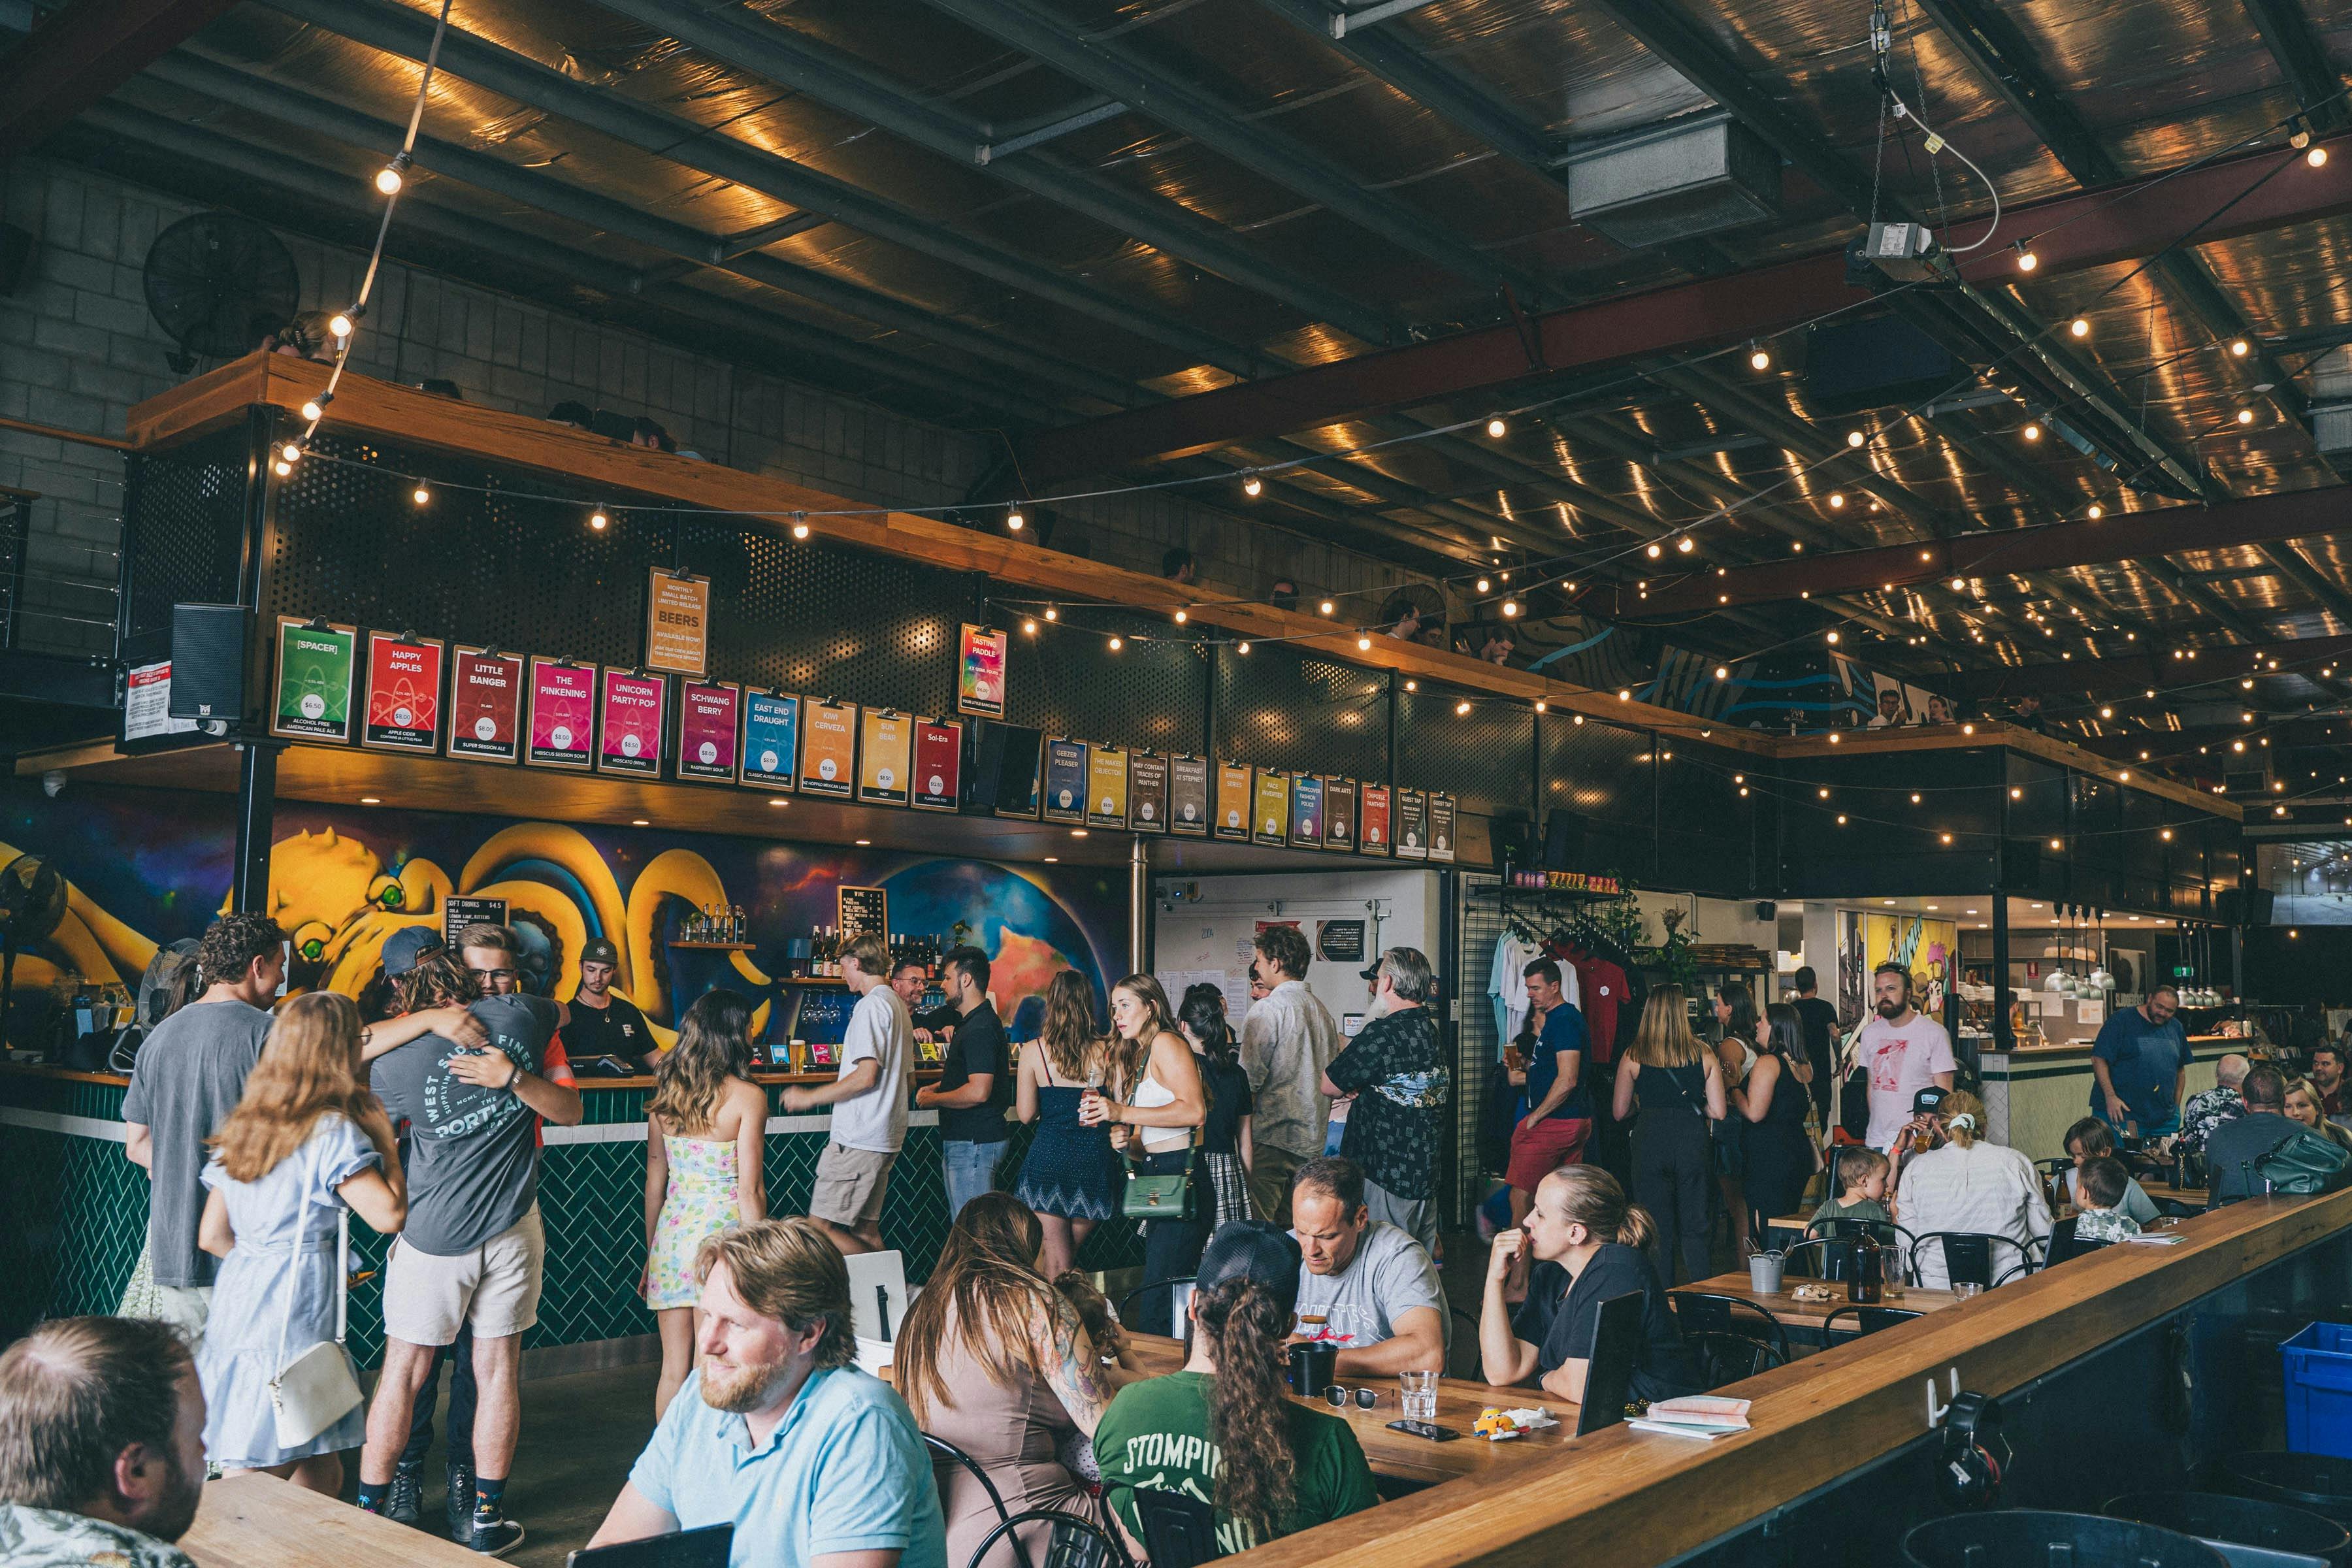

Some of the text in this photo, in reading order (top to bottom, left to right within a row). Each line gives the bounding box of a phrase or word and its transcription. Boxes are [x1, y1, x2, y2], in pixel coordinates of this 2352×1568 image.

[667, 584, 693, 594] MONTHLY
[659, 610, 699, 627] BEERS
[657, 631, 685, 640] AVAILABLE
[297, 640, 338, 655] [SPACER]
[972, 637, 997, 648] TASTING
[393, 651, 421, 661] HAPPY
[972, 647, 996, 658] PADDLE
[390, 662, 422, 672] APPLES
[475, 664, 503, 676] LITTLE
[470, 676, 506, 687] BANGER
[556, 676, 572, 685] THE
[541, 686, 587, 698] PINKENING
[616, 683, 653, 696] UNICORN
[612, 695, 656, 708] PARTY POP
[691, 694, 730, 706] SCHWANG
[698, 706, 723, 715] BERRY
[755, 704, 789, 715] EAST END
[754, 715, 789, 726] DRAUGHT
[823, 712, 838, 721] KIWI
[815, 721, 845, 732] CERVEZA
[928, 734, 948, 743] Sol-Era
[1056, 750, 1077, 759] GEEZER
[1054, 759, 1079, 768] PLEASER
[1094, 767, 1122, 776] OBJECTOR
[1176, 766, 1203, 774] BREAKFAST
[1262, 789, 1283, 798] INVERTER
[498, 1034, 534, 1073] FINES
[425, 1045, 467, 1123] WEST SID
[456, 1094, 478, 1105] MCML
[481, 1096, 497, 1105] THE
